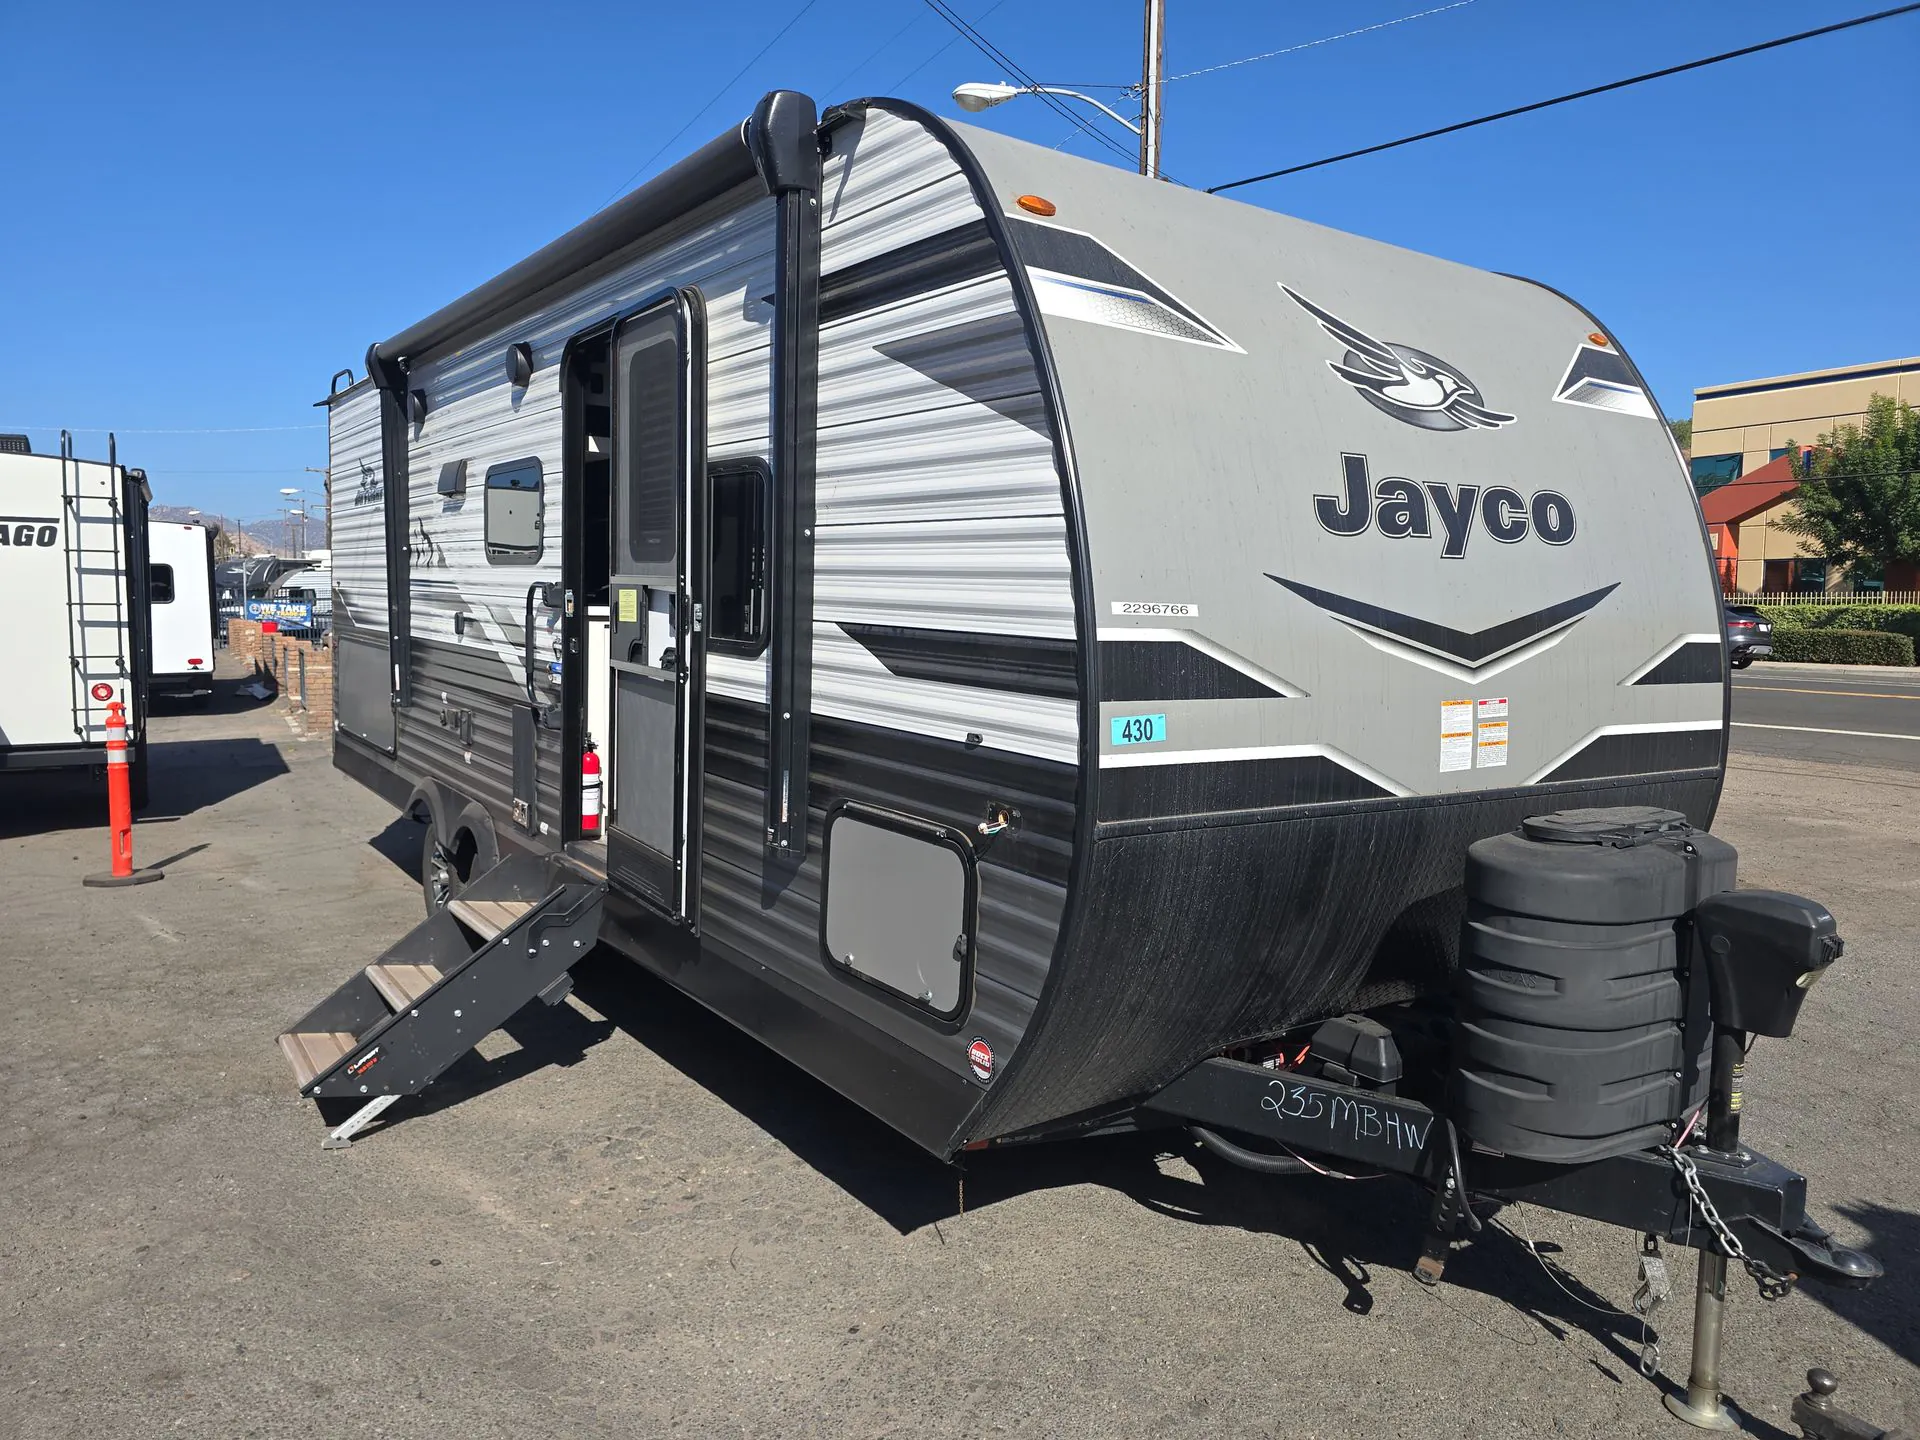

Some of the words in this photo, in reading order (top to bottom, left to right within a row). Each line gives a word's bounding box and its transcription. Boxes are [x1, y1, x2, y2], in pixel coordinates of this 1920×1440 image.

[1313, 451, 1577, 560] Jayco
[260, 603, 277, 612] WE
[279, 604, 307, 613] TAKE
[1122, 603, 1189, 615] 2296766
[1122, 718, 1153, 743] 430
[971, 1048, 990, 1061] ROCK
[971, 1055, 990, 1068] SOLID
[1260, 1080, 1435, 1150] 235MBHW
